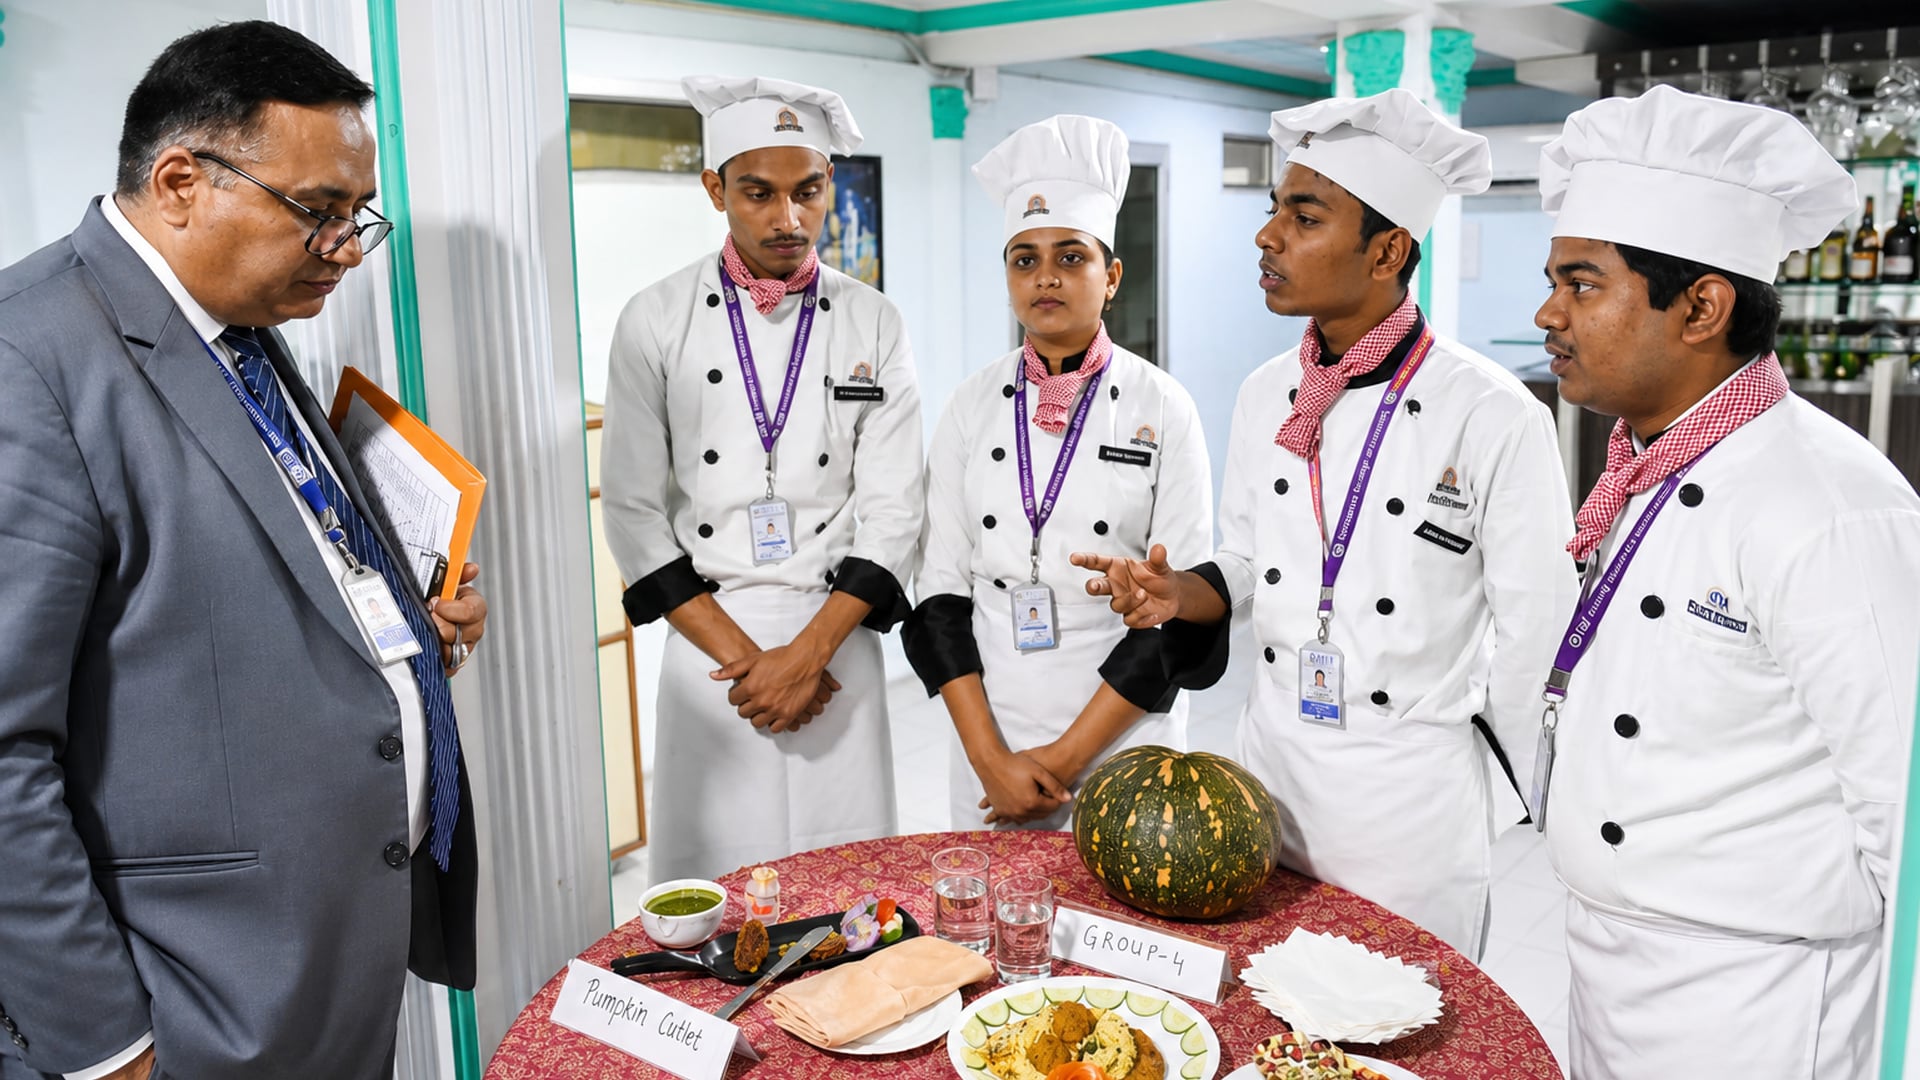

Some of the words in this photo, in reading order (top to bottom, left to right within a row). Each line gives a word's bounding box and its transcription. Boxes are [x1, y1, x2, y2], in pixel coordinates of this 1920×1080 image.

[1083, 924, 1184, 976] GROUP-4
[583, 978, 648, 1027] Pumpkin
[658, 1012, 702, 1051] Cutlet
